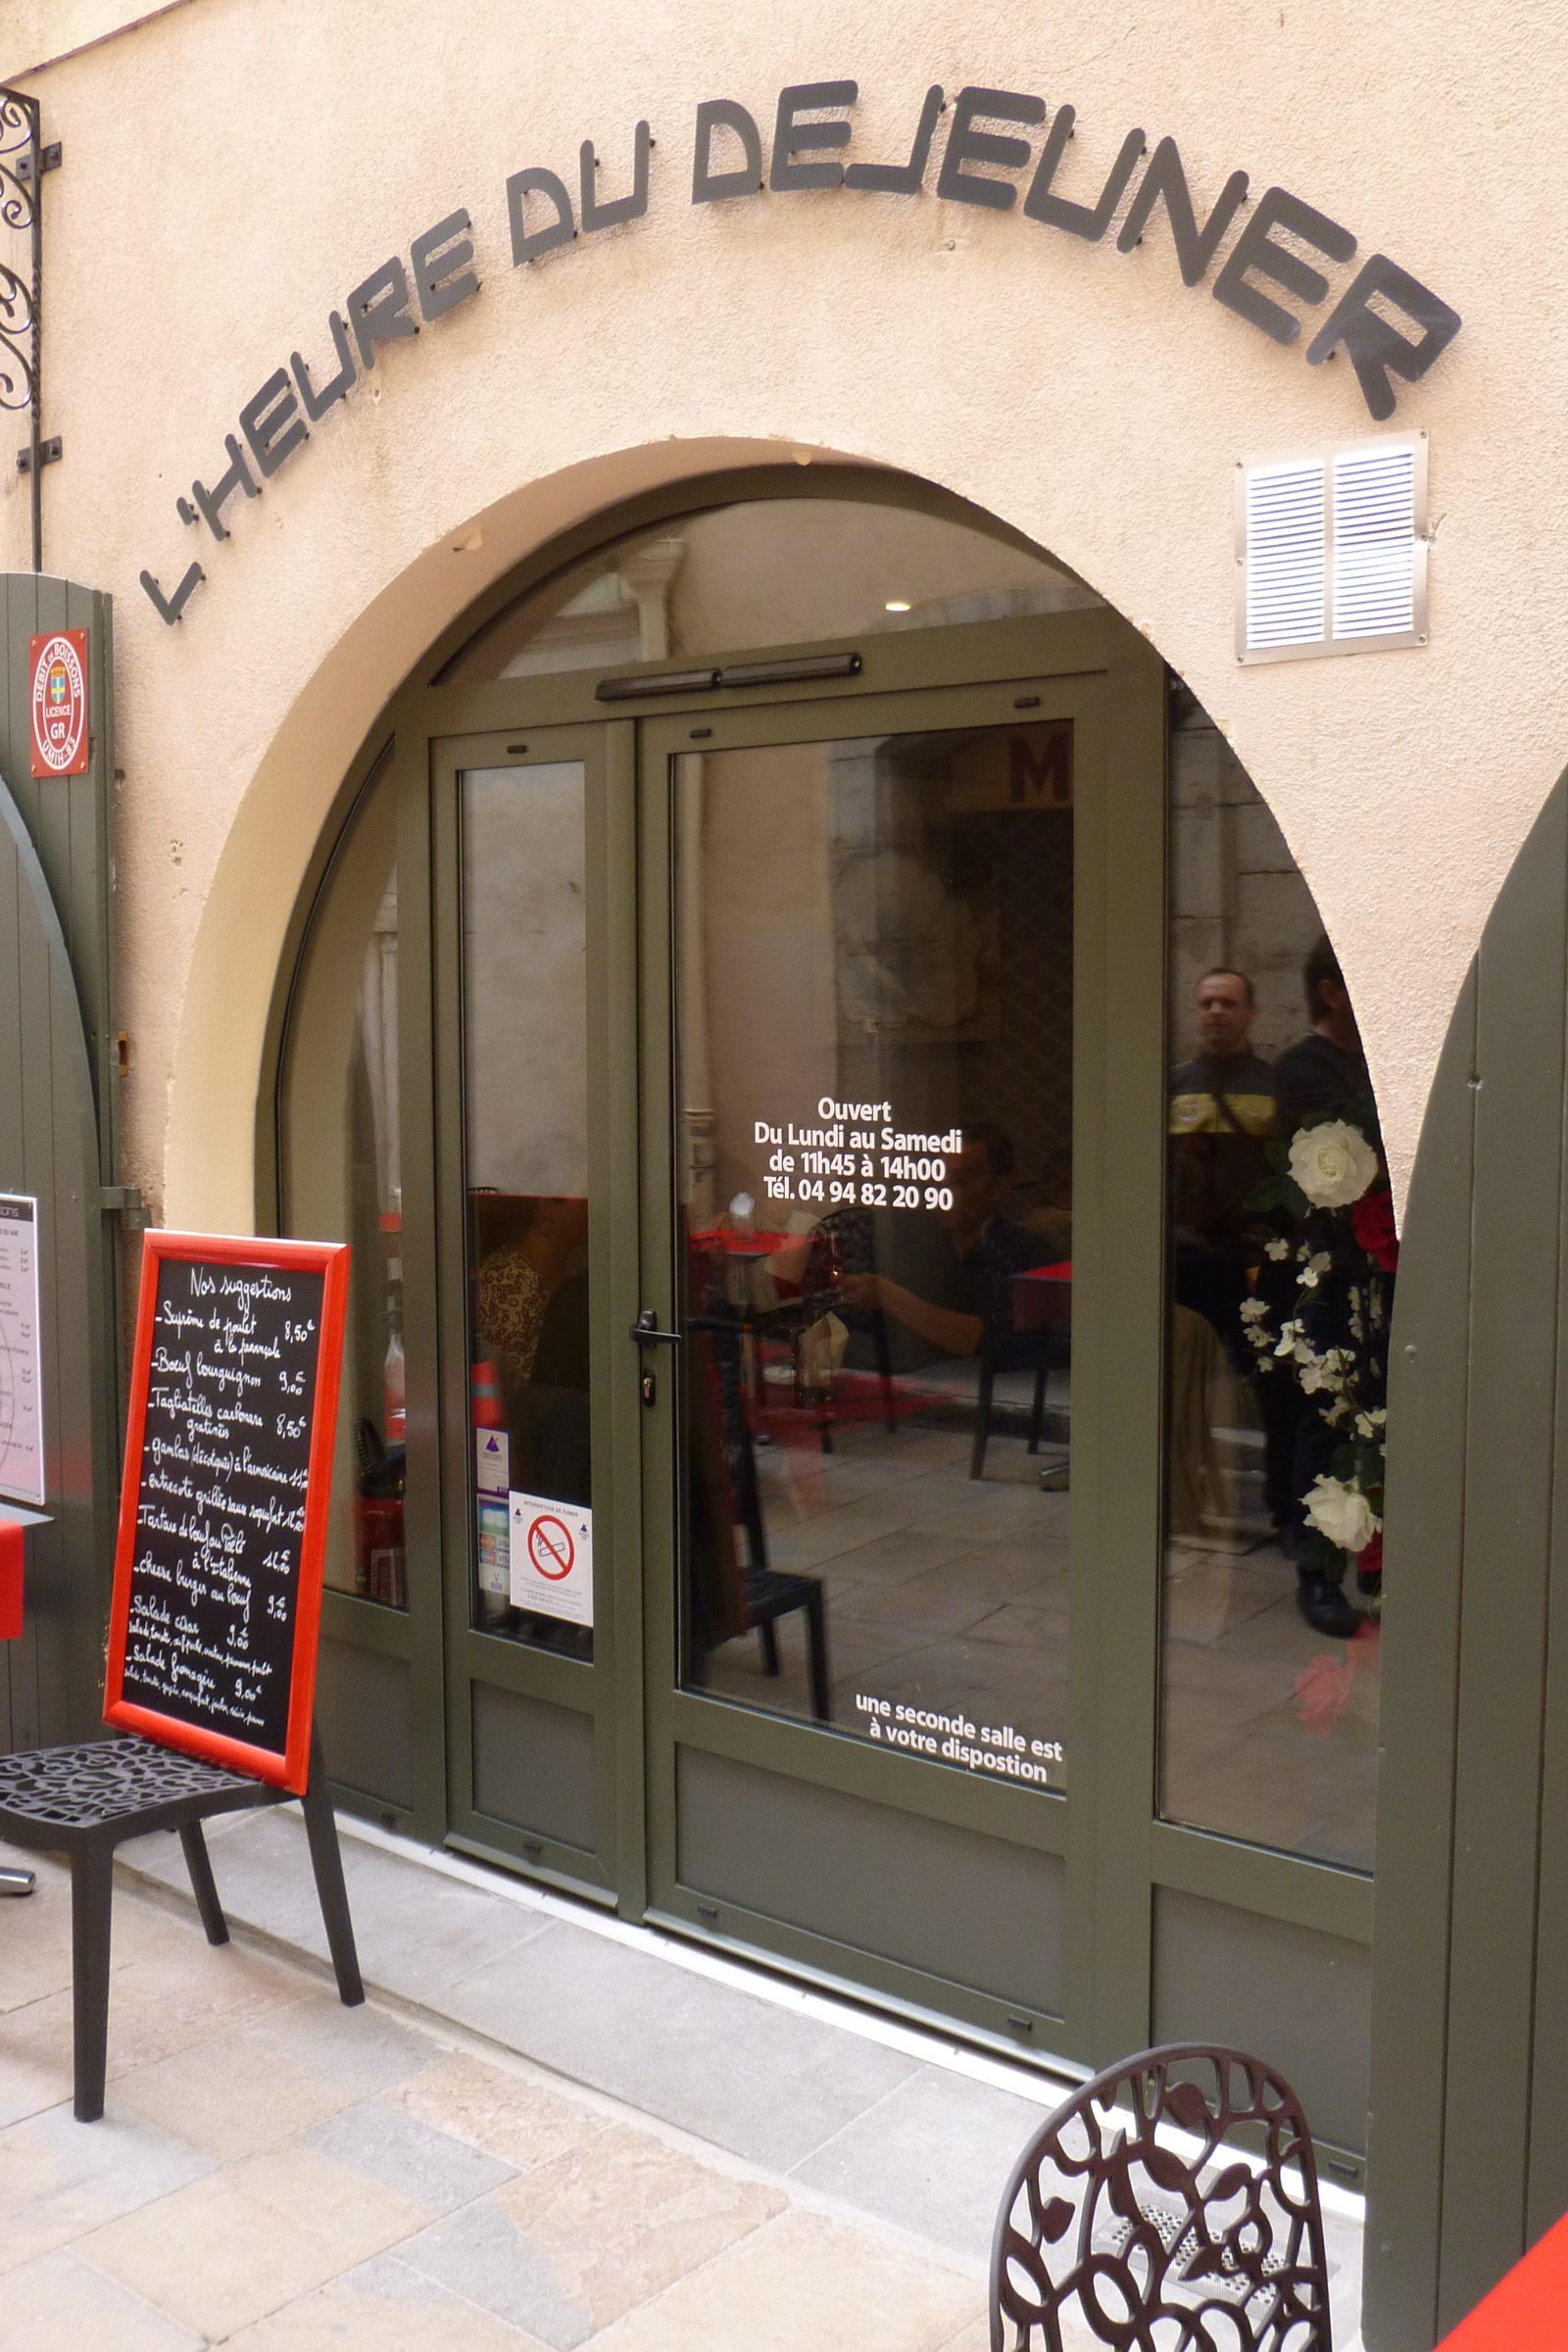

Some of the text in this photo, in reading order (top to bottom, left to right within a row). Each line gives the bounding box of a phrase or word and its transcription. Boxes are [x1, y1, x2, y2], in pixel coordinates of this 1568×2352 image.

[139, 79, 1462, 626] L'HEURE DU DEJEUNER
[54, 644, 80, 699] BOISSONS
[45, 705, 72, 717] LICENCE
[50, 722, 65, 740] GR
[817, 1097, 892, 1122] Ouvert
[754, 1121, 962, 1153] Du Lundi au Samedi
[769, 1149, 946, 1182] de 11h45 à 14h00
[763, 1175, 954, 1211] Tél. 04 94 82 20 90
[190, 1266, 292, 1311] Nos suggestions
[209, 1307, 220, 1329] de
[222, 1311, 257, 1346] poulet
[214, 1339, 223, 1353] à
[228, 1333, 237, 1353] la
[196, 1351, 261, 1396] bourguignon
[217, 1401, 264, 1427] carbonara
[233, 1457, 242, 1473] à
[192, 1552, 201, 1570] à
[176, 1559, 207, 1606] burger
[211, 1590, 224, 1602] au
[856, 1693, 1063, 1762] une seconde salle est
[869, 1717, 1048, 1783] à votre dispostion
